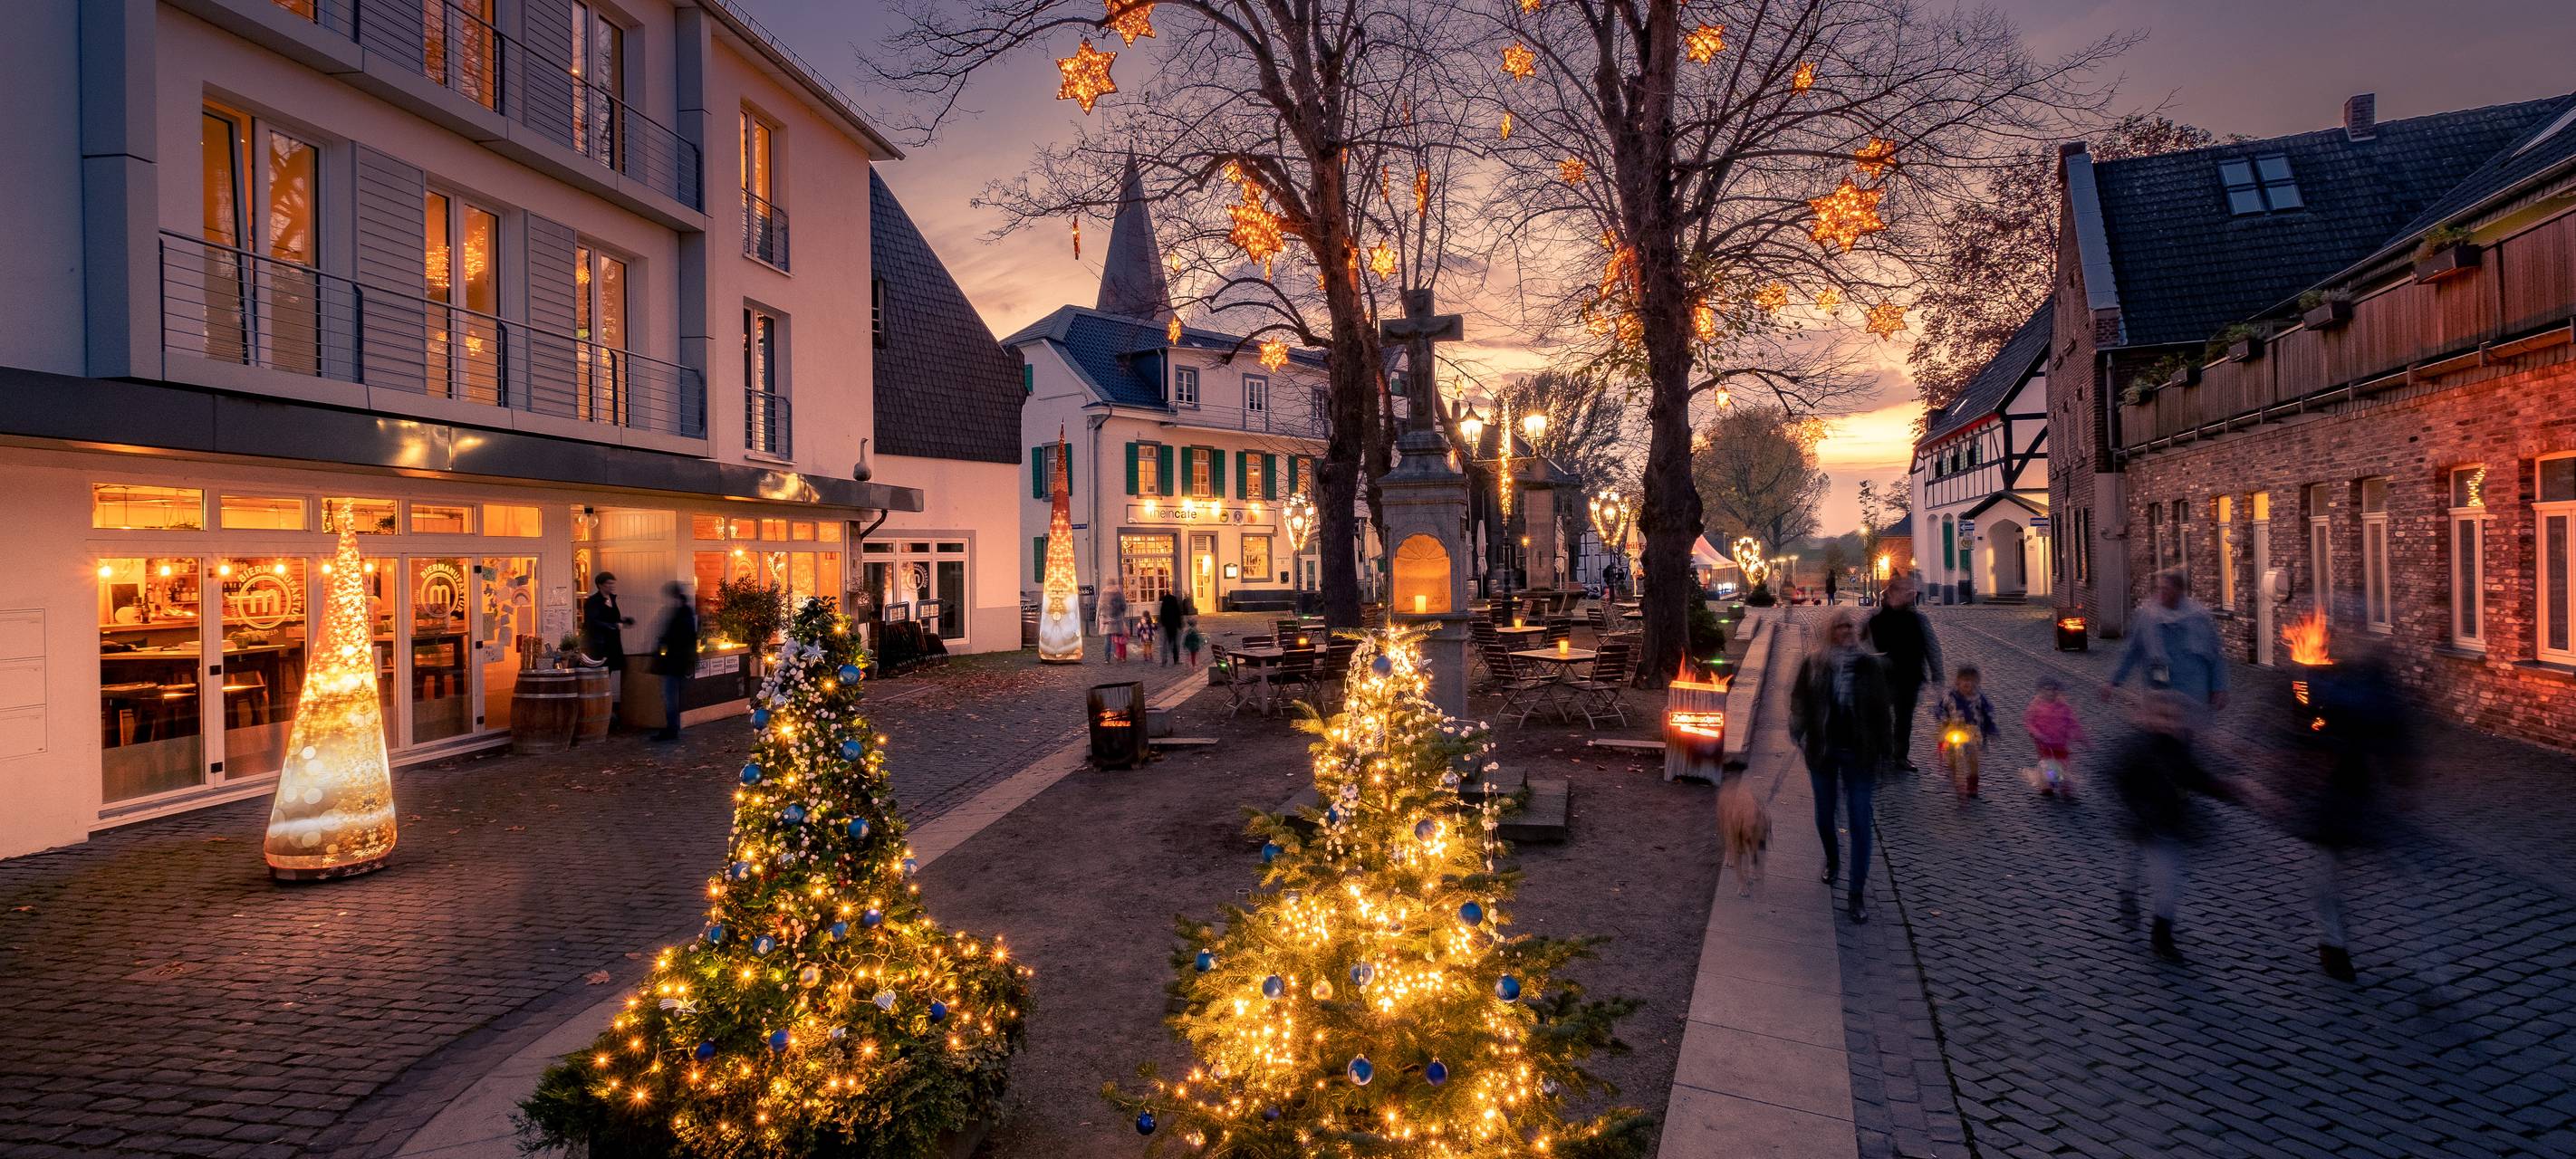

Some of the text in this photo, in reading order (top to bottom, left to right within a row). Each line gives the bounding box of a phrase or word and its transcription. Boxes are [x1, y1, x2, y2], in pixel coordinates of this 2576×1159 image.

[237, 564, 303, 623] BIERMUFAKTUR
[249, 588, 283, 614] m
[428, 584, 451, 605] m
